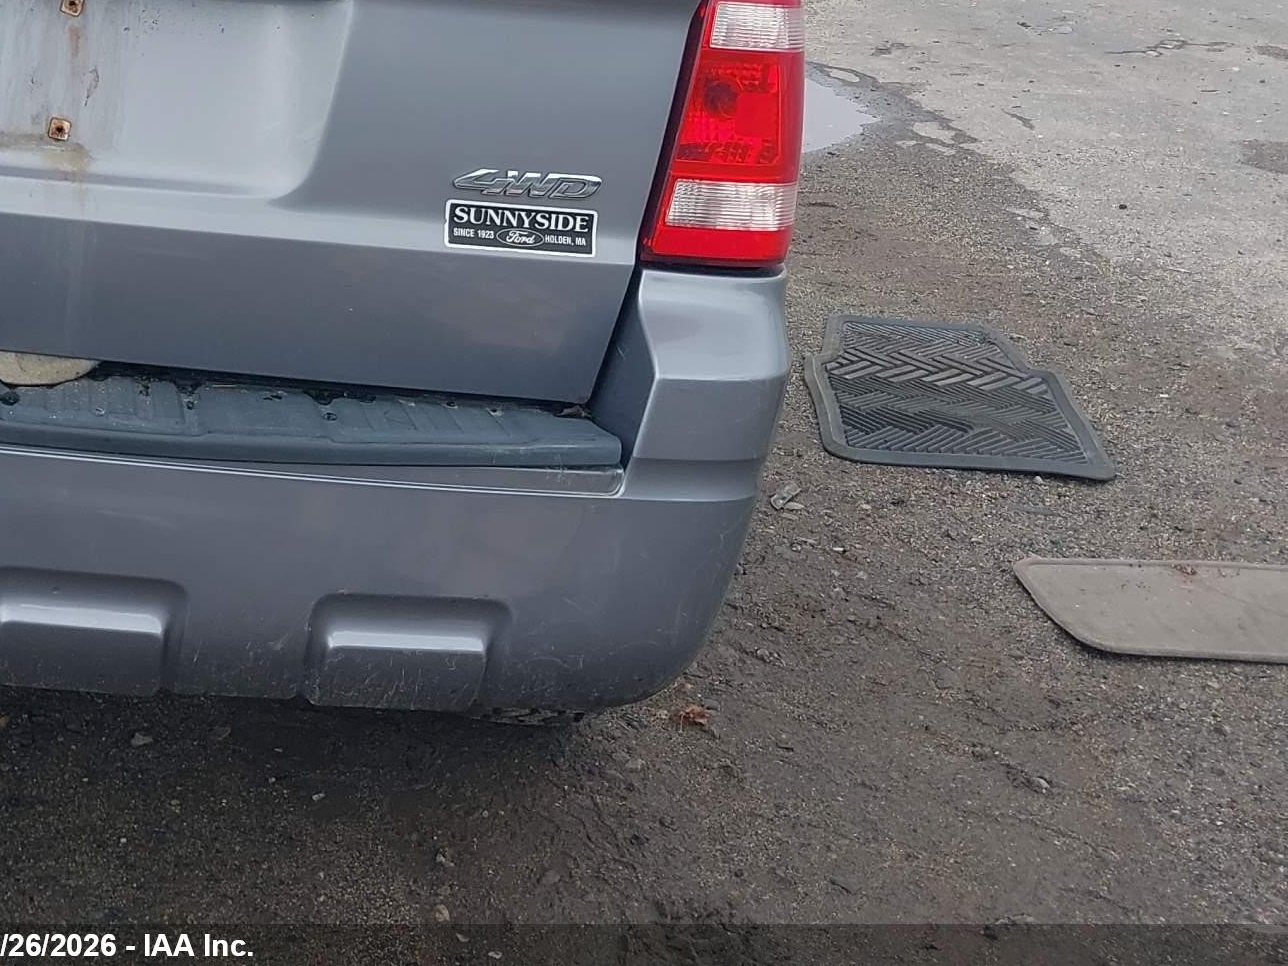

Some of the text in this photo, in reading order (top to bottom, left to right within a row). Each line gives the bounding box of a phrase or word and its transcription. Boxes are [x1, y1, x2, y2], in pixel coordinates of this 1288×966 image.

[453, 168, 603, 200] 4WD
[453, 206, 590, 233] SUNNYSIDE
[453, 227, 587, 247] SINCE 1923 Ford HOLDEN, MA
